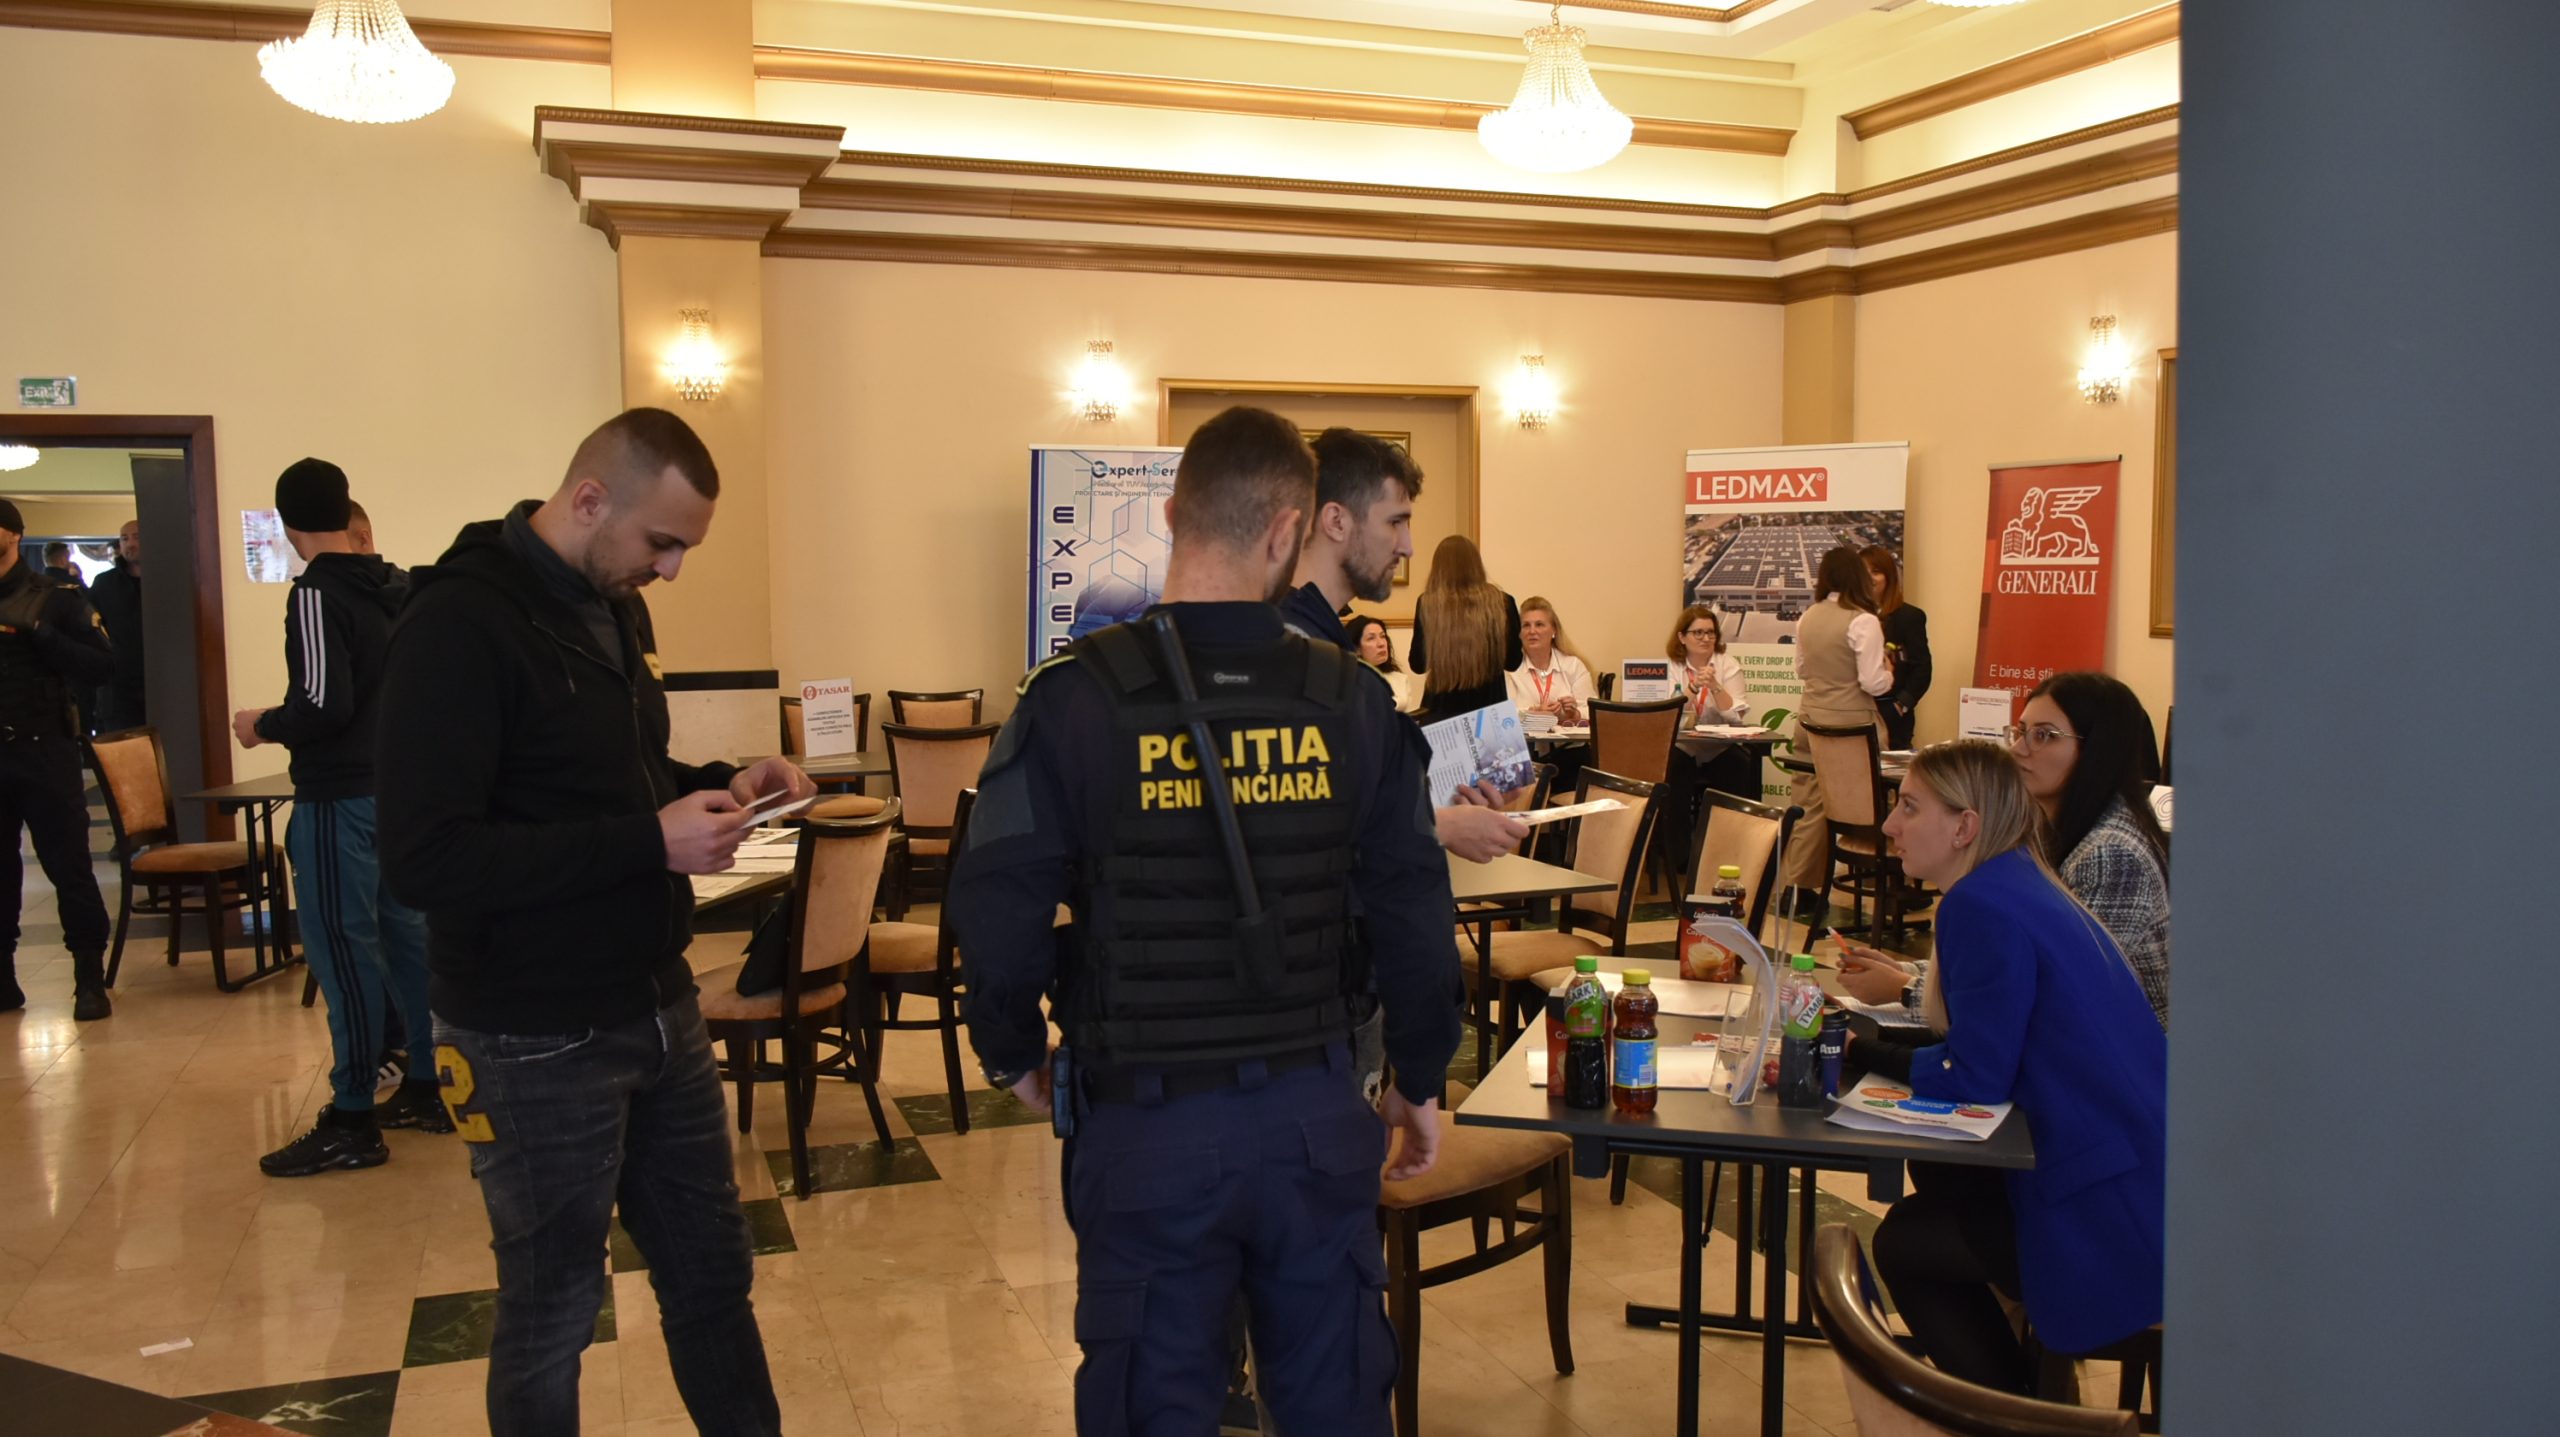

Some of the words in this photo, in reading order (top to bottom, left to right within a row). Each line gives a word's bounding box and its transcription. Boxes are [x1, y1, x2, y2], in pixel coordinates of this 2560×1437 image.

[1997, 570, 2098, 595] GENERALI
[1627, 667, 1665, 675] LEDMAX
[1744, 656, 1765, 665] EVERY
[1766, 656, 1784, 665] DROP
[1785, 657, 1794, 666] OF
[1990, 664, 1997, 677] E
[1999, 665, 2021, 679] bine
[2023, 667, 2036, 679] să
[1744, 684, 1772, 693] LEAVING
[1773, 685, 1787, 694] OUR
[1139, 726, 1330, 773] POIȚIA
[1141, 766, 1331, 810] PENINCIARĂ
[434, 1044, 496, 1142] 2
